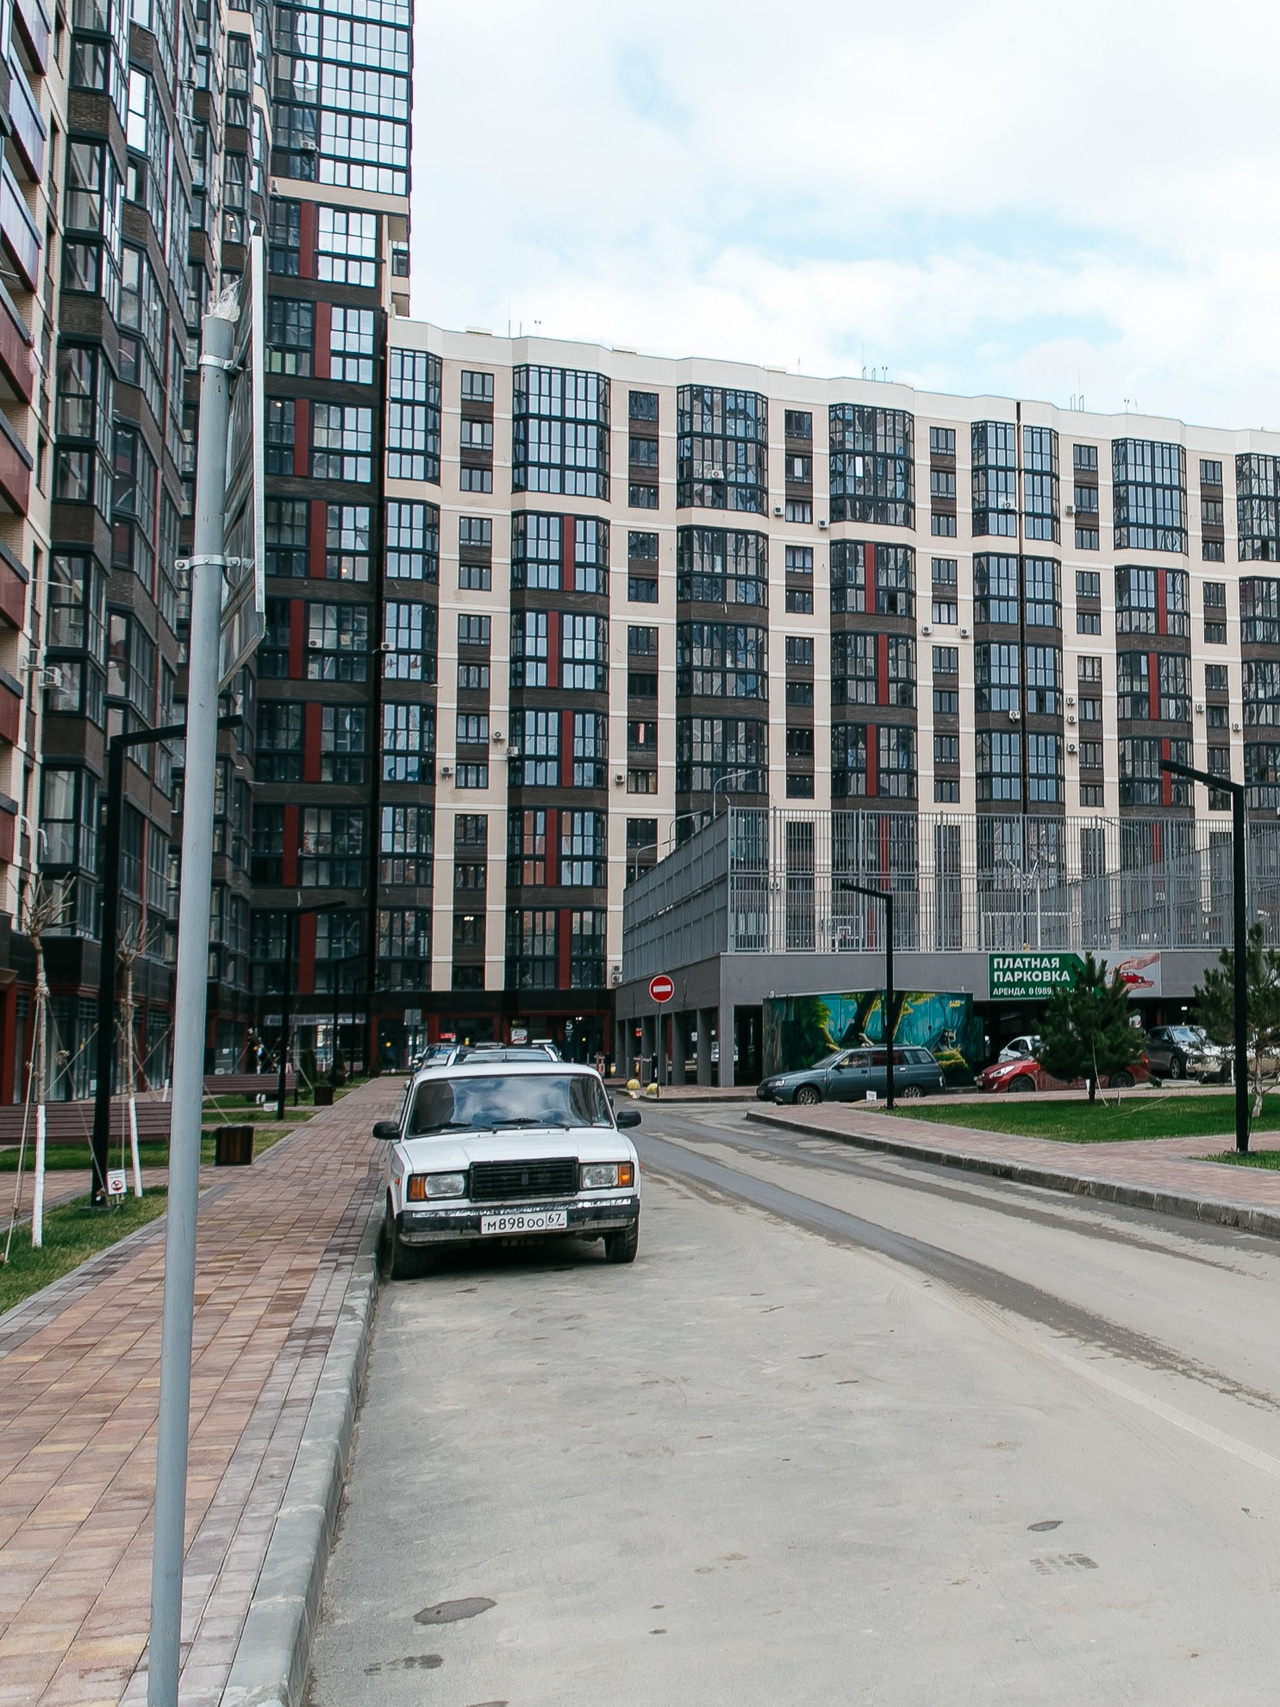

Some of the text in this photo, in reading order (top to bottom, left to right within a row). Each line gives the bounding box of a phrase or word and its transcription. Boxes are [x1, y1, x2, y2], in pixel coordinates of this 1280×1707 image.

[993, 957, 1060, 969] ПЛАТНАЯ
[993, 970, 1070, 982] ПАРКОВКА
[993, 987, 1026, 996] АРЕНДА
[566, 1020, 573, 1030] 5
[548, 1213, 561, 1223] 67
